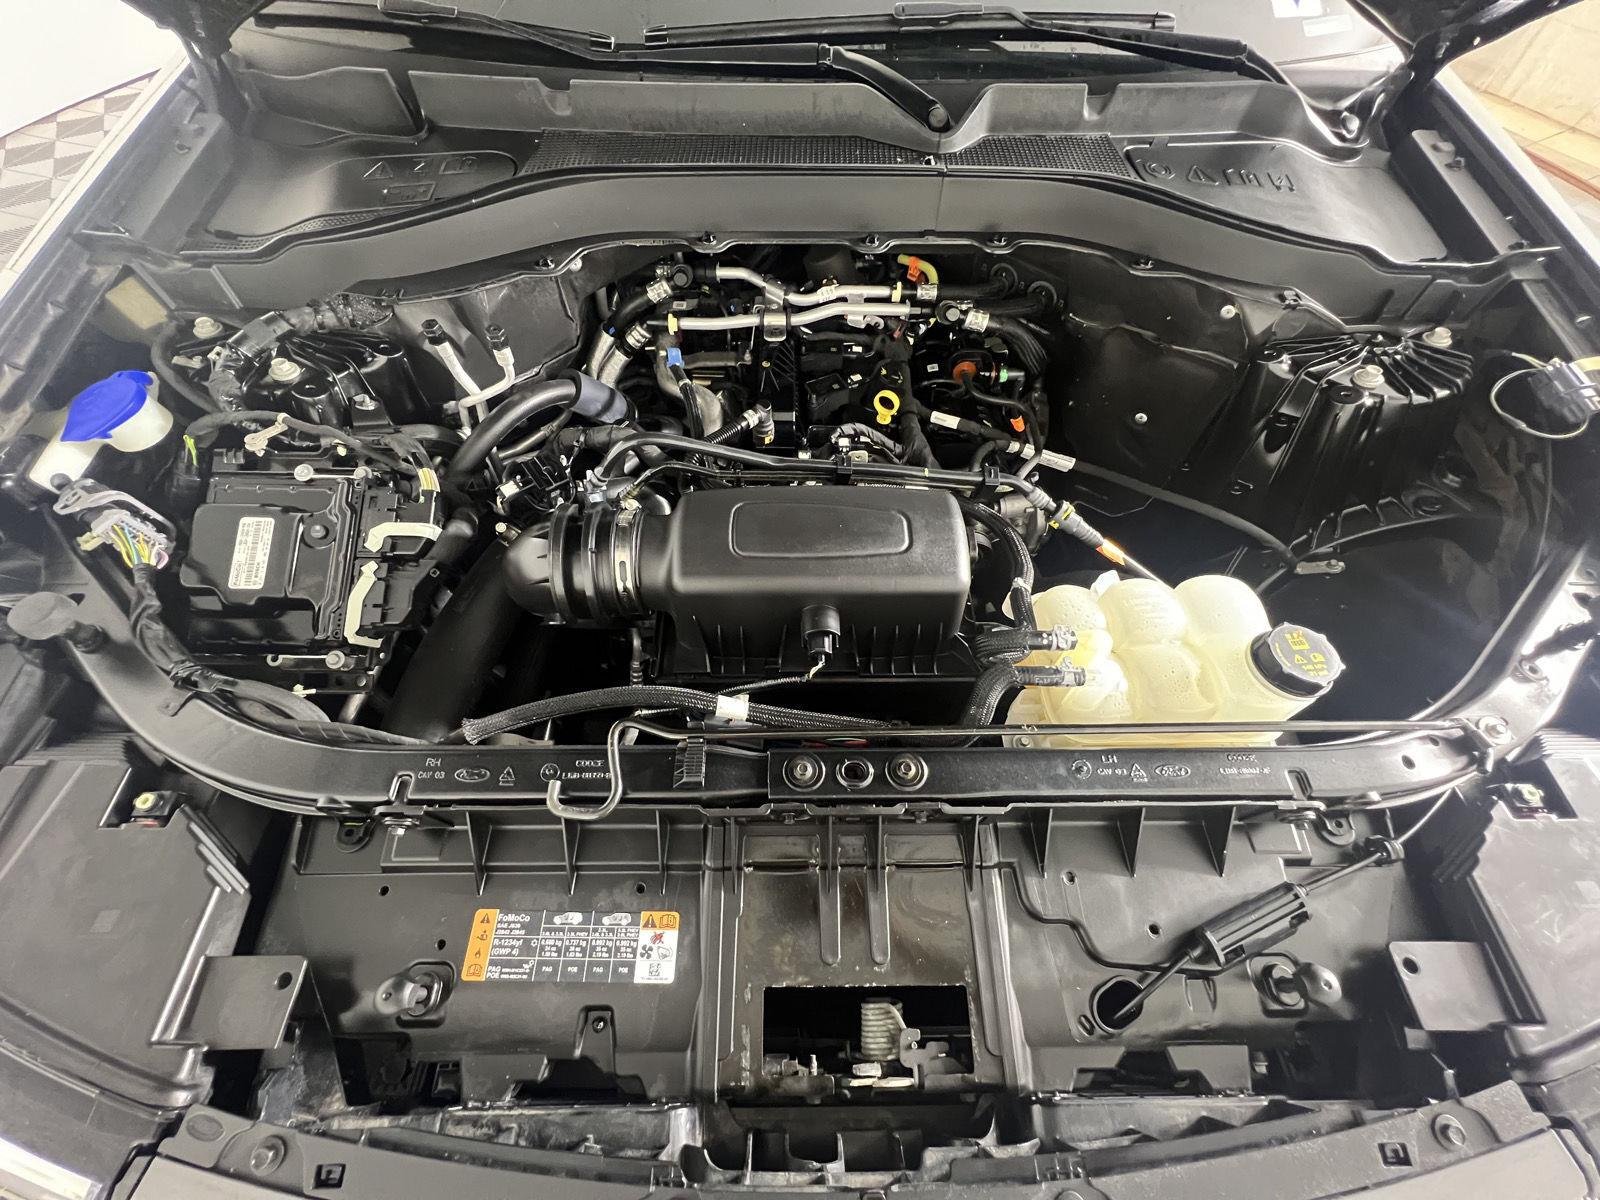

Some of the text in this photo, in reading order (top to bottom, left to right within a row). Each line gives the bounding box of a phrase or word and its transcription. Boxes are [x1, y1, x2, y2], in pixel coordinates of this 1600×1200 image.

[426, 758, 441, 766] RH
[1102, 755, 1118, 764] LH
[498, 914, 530, 922] FoMoCo
[494, 939, 523, 947] R-1234yf
[512, 948, 519, 956] 4)
